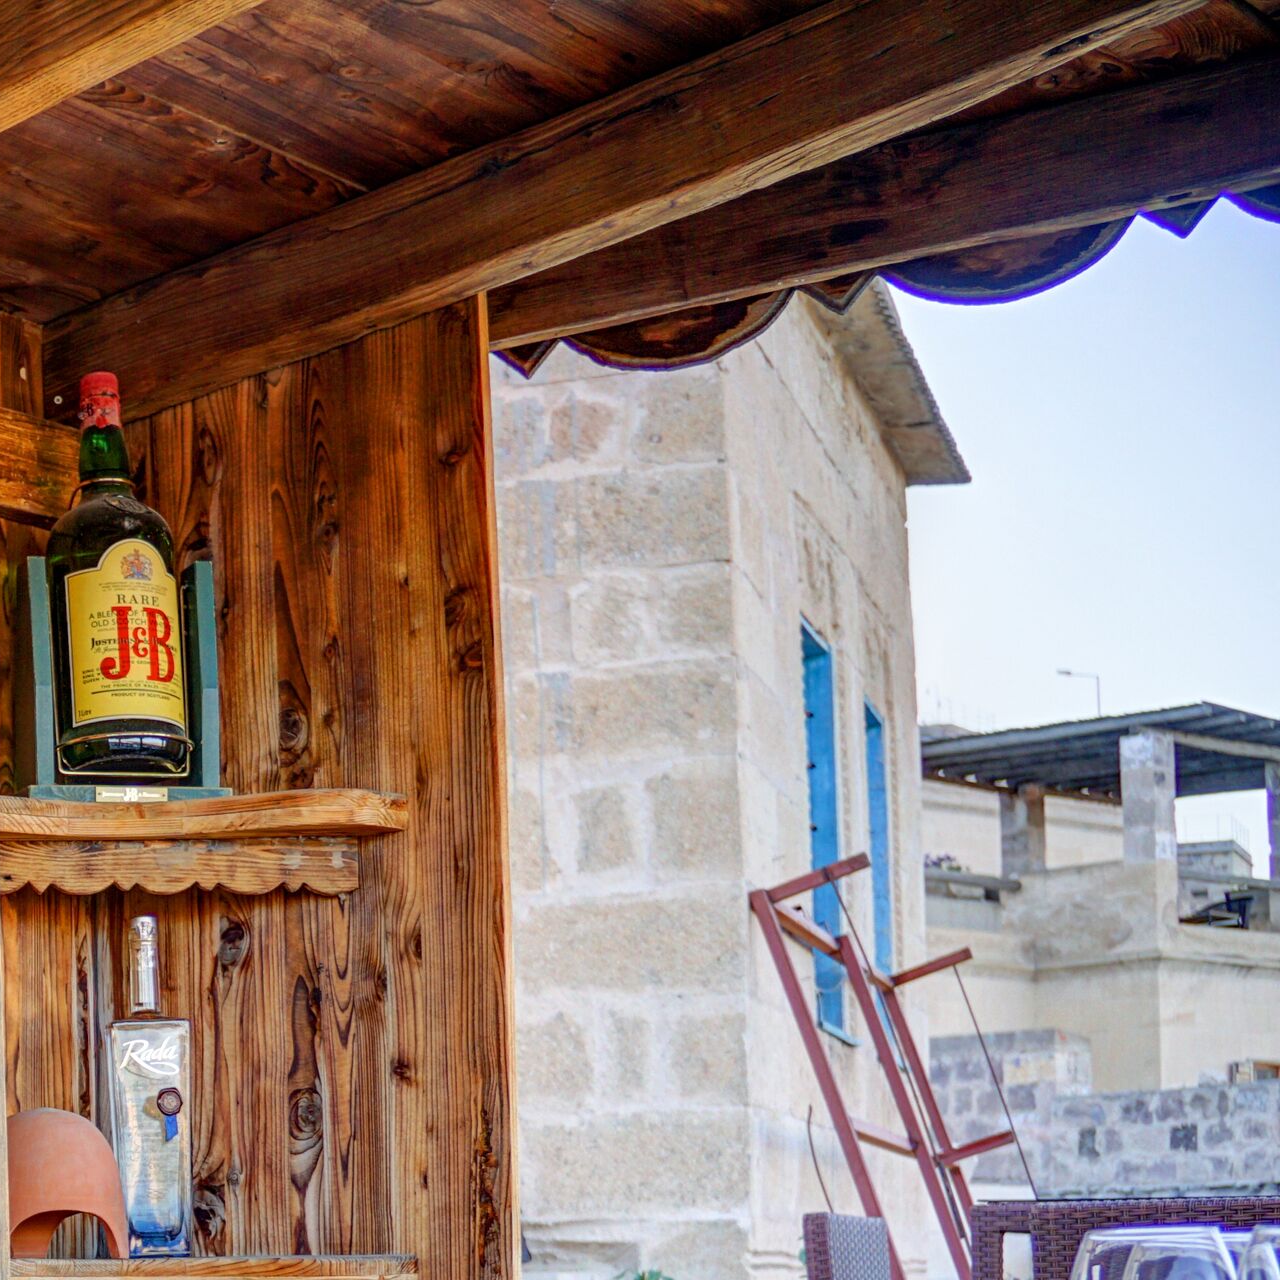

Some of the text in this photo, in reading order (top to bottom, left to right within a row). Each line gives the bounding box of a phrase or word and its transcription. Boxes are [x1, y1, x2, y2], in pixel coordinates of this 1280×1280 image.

[117, 593, 160, 607] RARE
[91, 619, 109, 628] OLD
[99, 605, 176, 683] J&B
[120, 1037, 180, 1075] Rada
